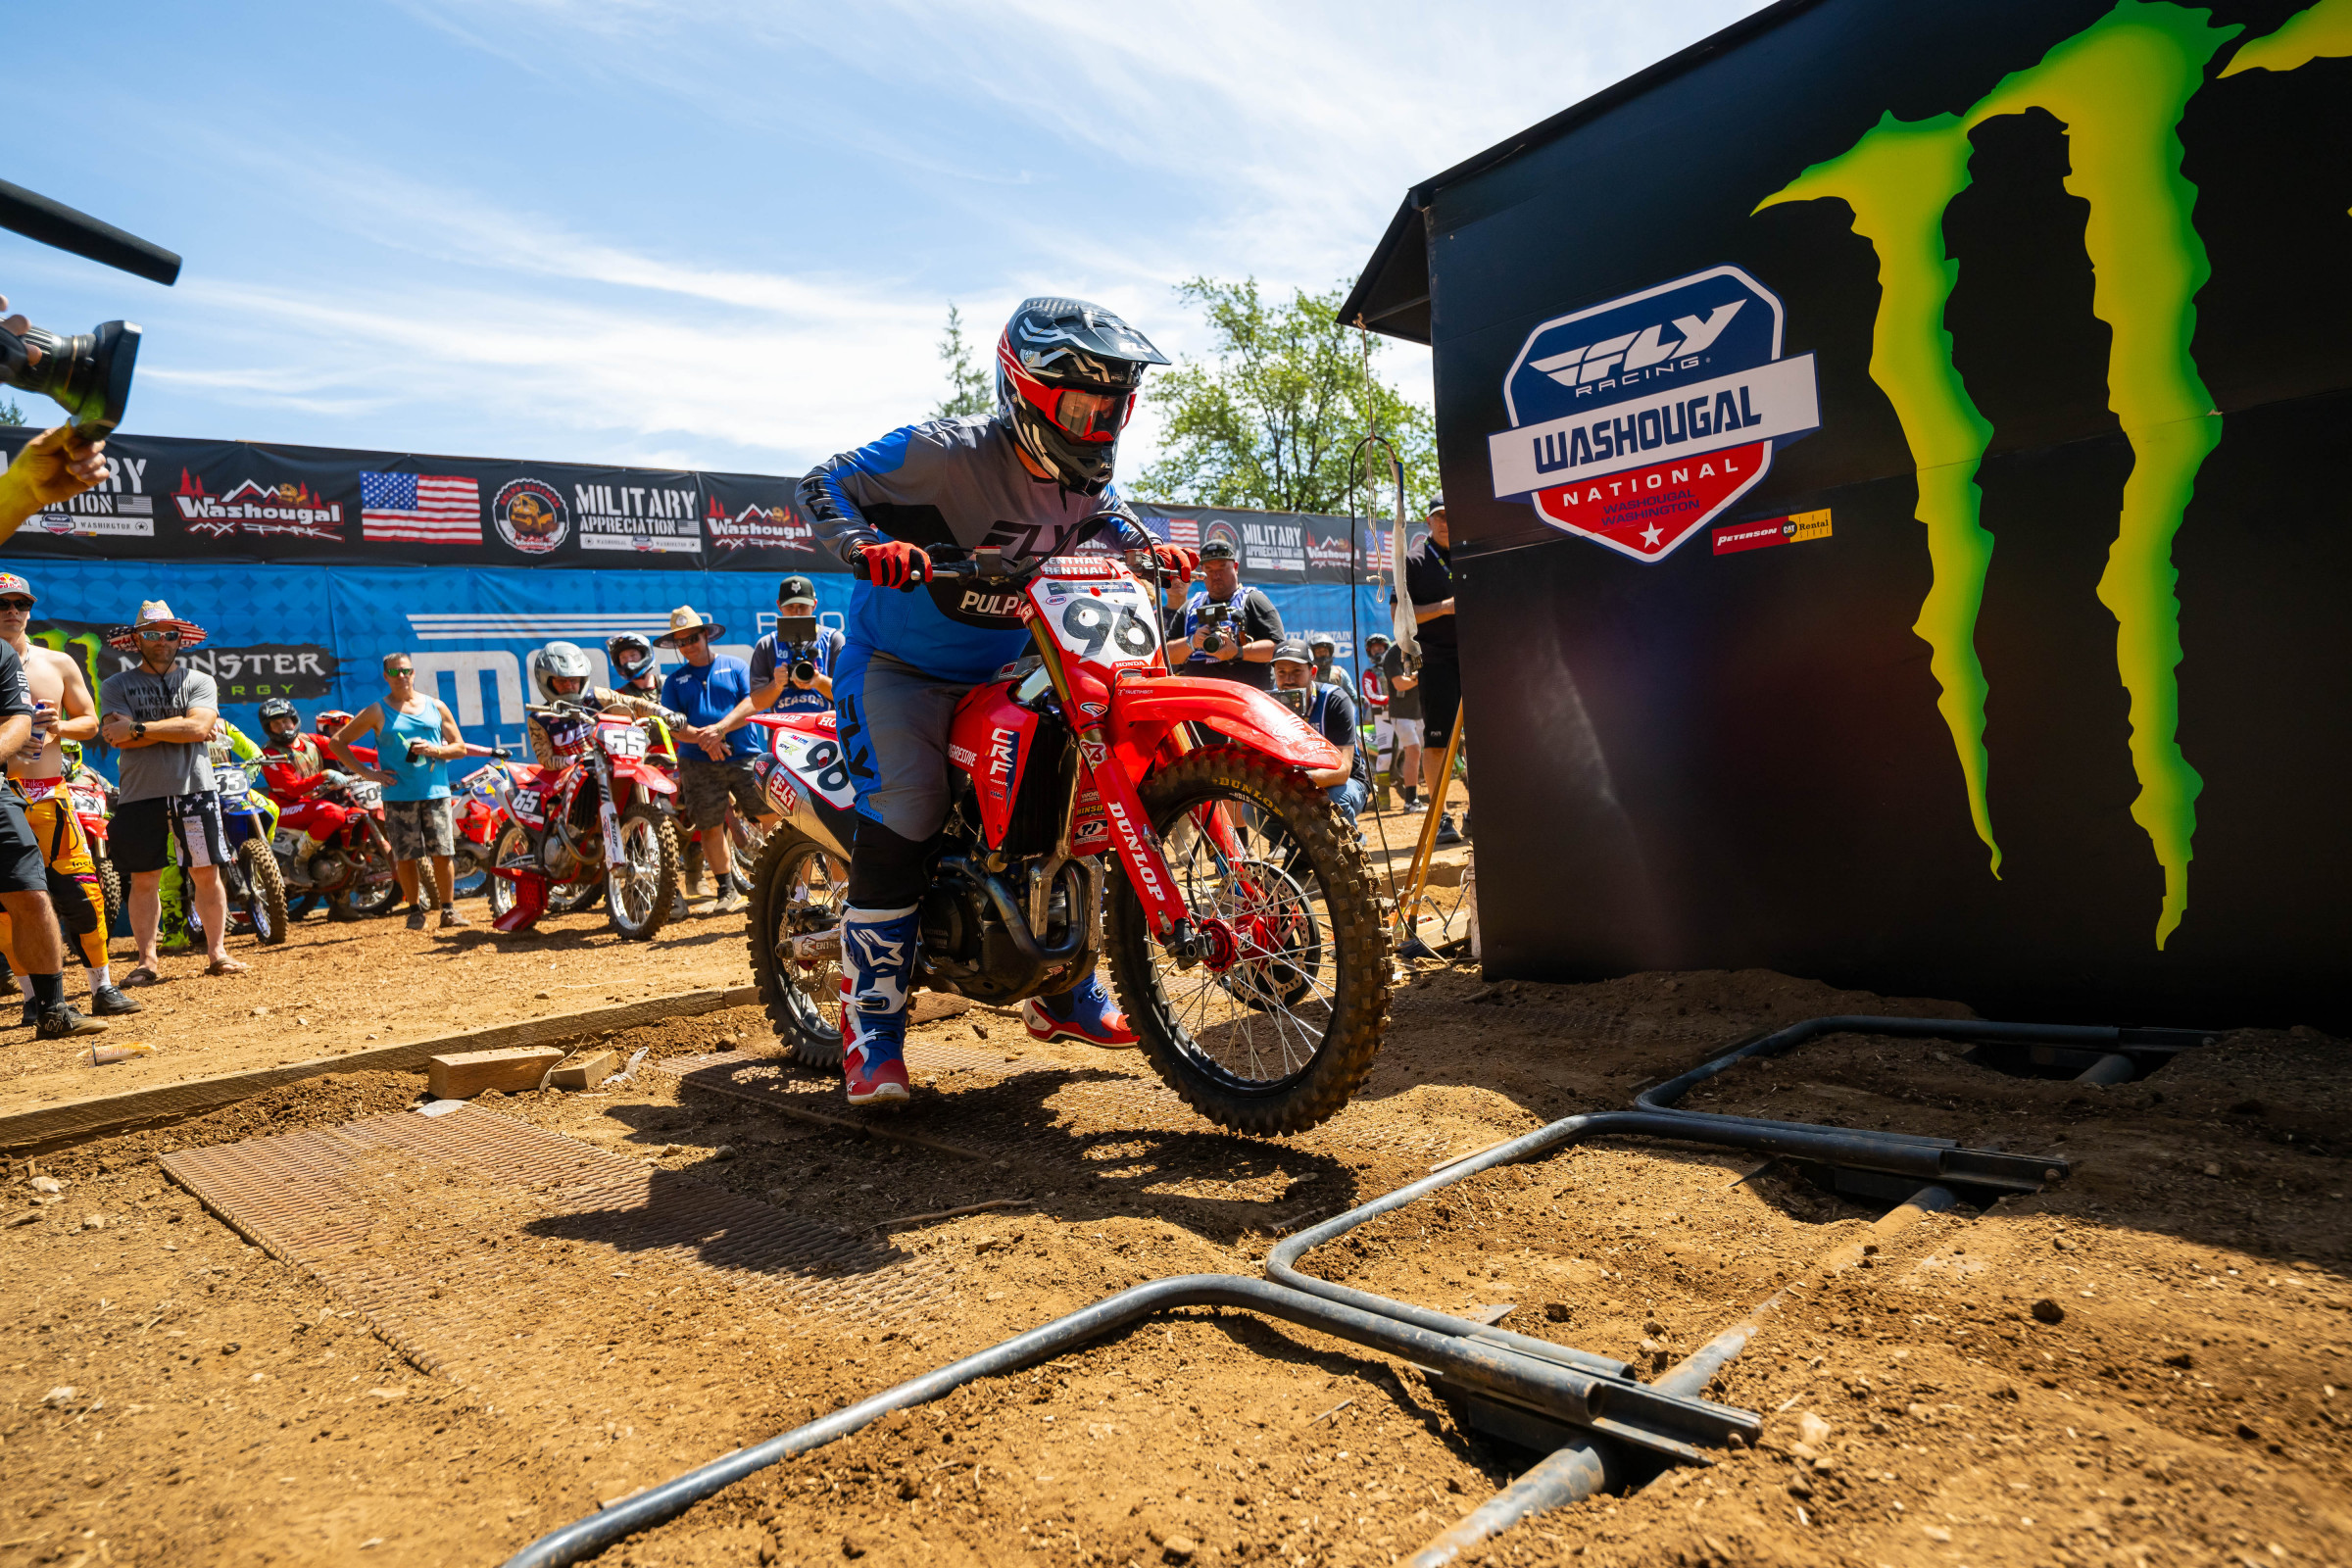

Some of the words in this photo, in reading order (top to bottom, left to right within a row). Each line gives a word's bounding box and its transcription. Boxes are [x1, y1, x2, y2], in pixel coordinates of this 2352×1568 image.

[1529, 299, 1747, 387] FLY
[1576, 356, 1700, 398] RACING
[1533, 385, 1762, 474] WASHOUGAL
[1563, 459, 1739, 507] NATIONAL
[175, 495, 341, 525] Washougal
[574, 483, 696, 519] MILITARY
[1601, 499, 1700, 526] WASHINGTON
[1602, 490, 1696, 514] WASHOUGAL
[80, 521, 131, 530] WASHINGTON
[579, 515, 676, 535] APPRECIATION
[707, 516, 812, 539] Washougal
[1242, 523, 1301, 547] MILITARY
[1717, 527, 1777, 547] PETERSON
[1783, 524, 1795, 534] CAT
[1799, 519, 1829, 530] Rental
[978, 520, 1080, 562] FLY
[1246, 545, 1293, 559] APPRECIATION
[1306, 547, 1360, 562] Washougl
[1044, 566, 1108, 575] RENTHAL
[1062, 598, 1155, 662] 96
[777, 694, 825, 709] SEASON
[604, 729, 647, 758] 65
[838, 694, 875, 779] FLY
[990, 727, 1015, 775] CRF
[796, 741, 850, 792] 96
[512, 789, 541, 813] 65
[1219, 777, 1285, 817] DUNLOP
[1081, 823, 1099, 835] TJ
[1107, 801, 1165, 902] DUNLOP
